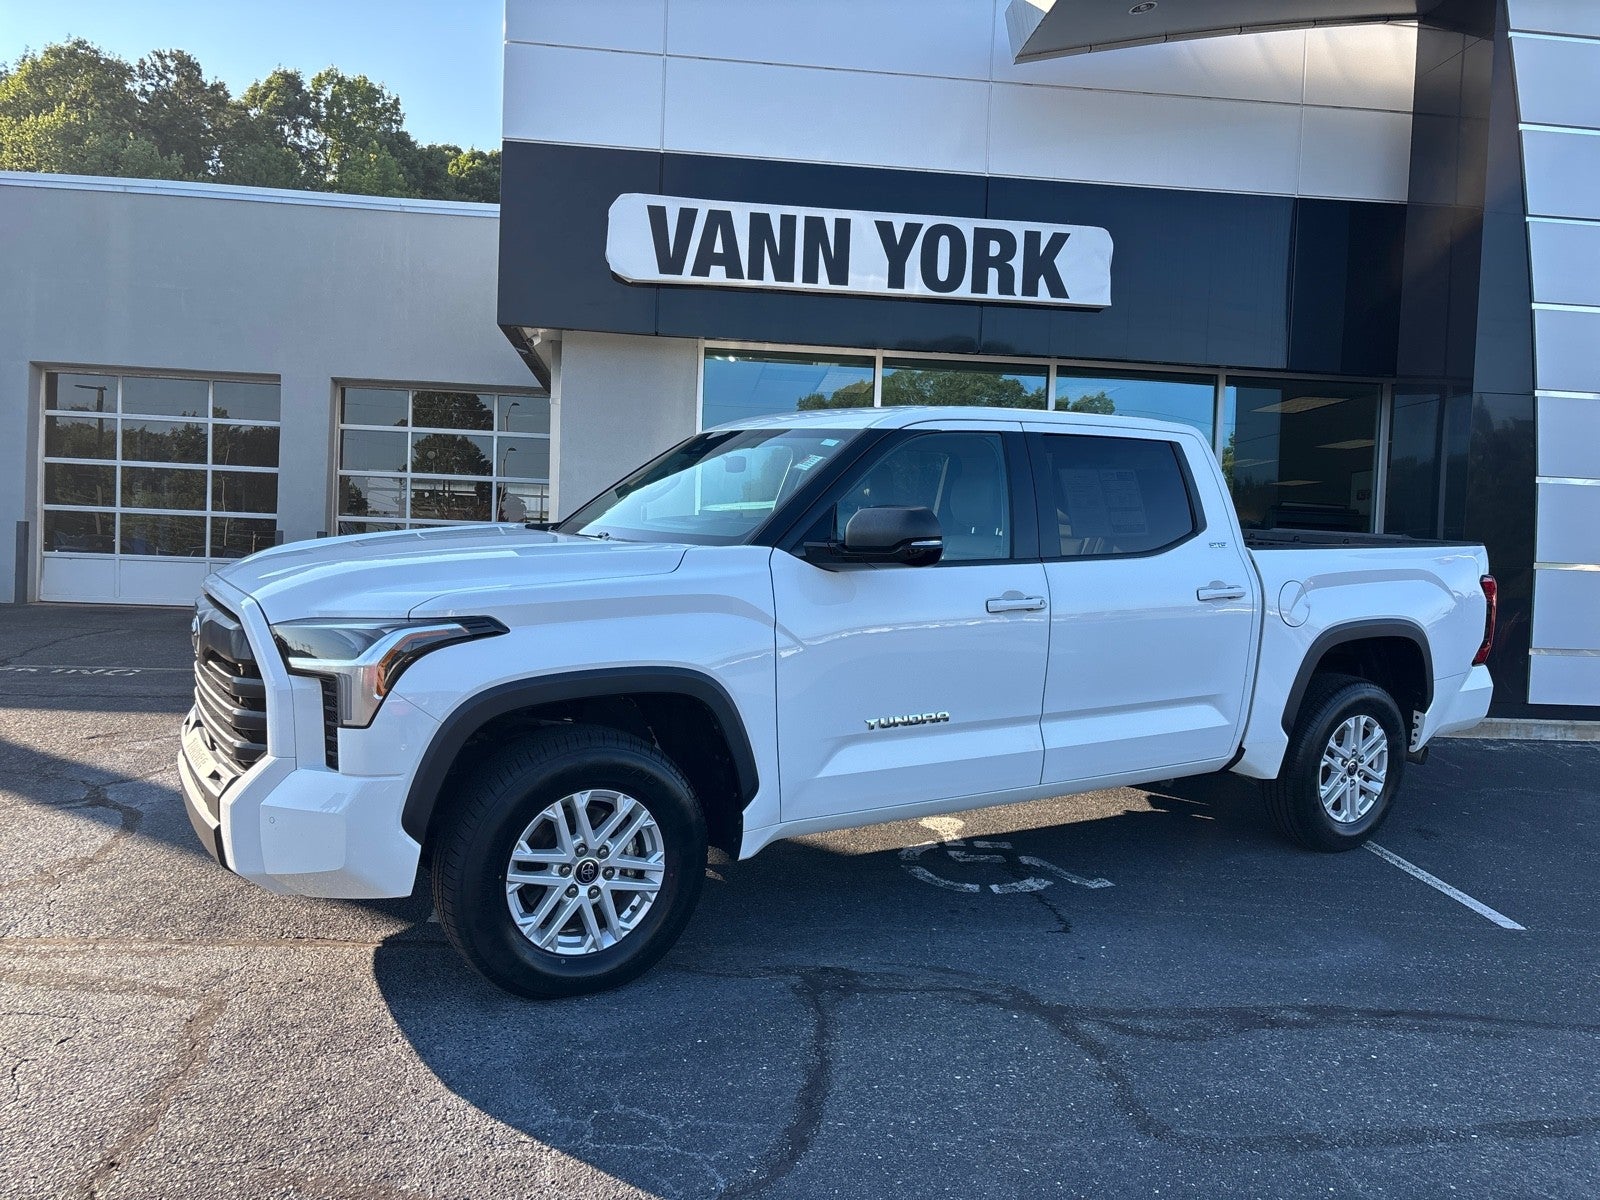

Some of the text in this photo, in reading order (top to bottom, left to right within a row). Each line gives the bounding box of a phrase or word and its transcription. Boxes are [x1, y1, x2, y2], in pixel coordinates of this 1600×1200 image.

[647, 205, 1070, 299] VANN YORK
[864, 711, 950, 730] TUNDRA
